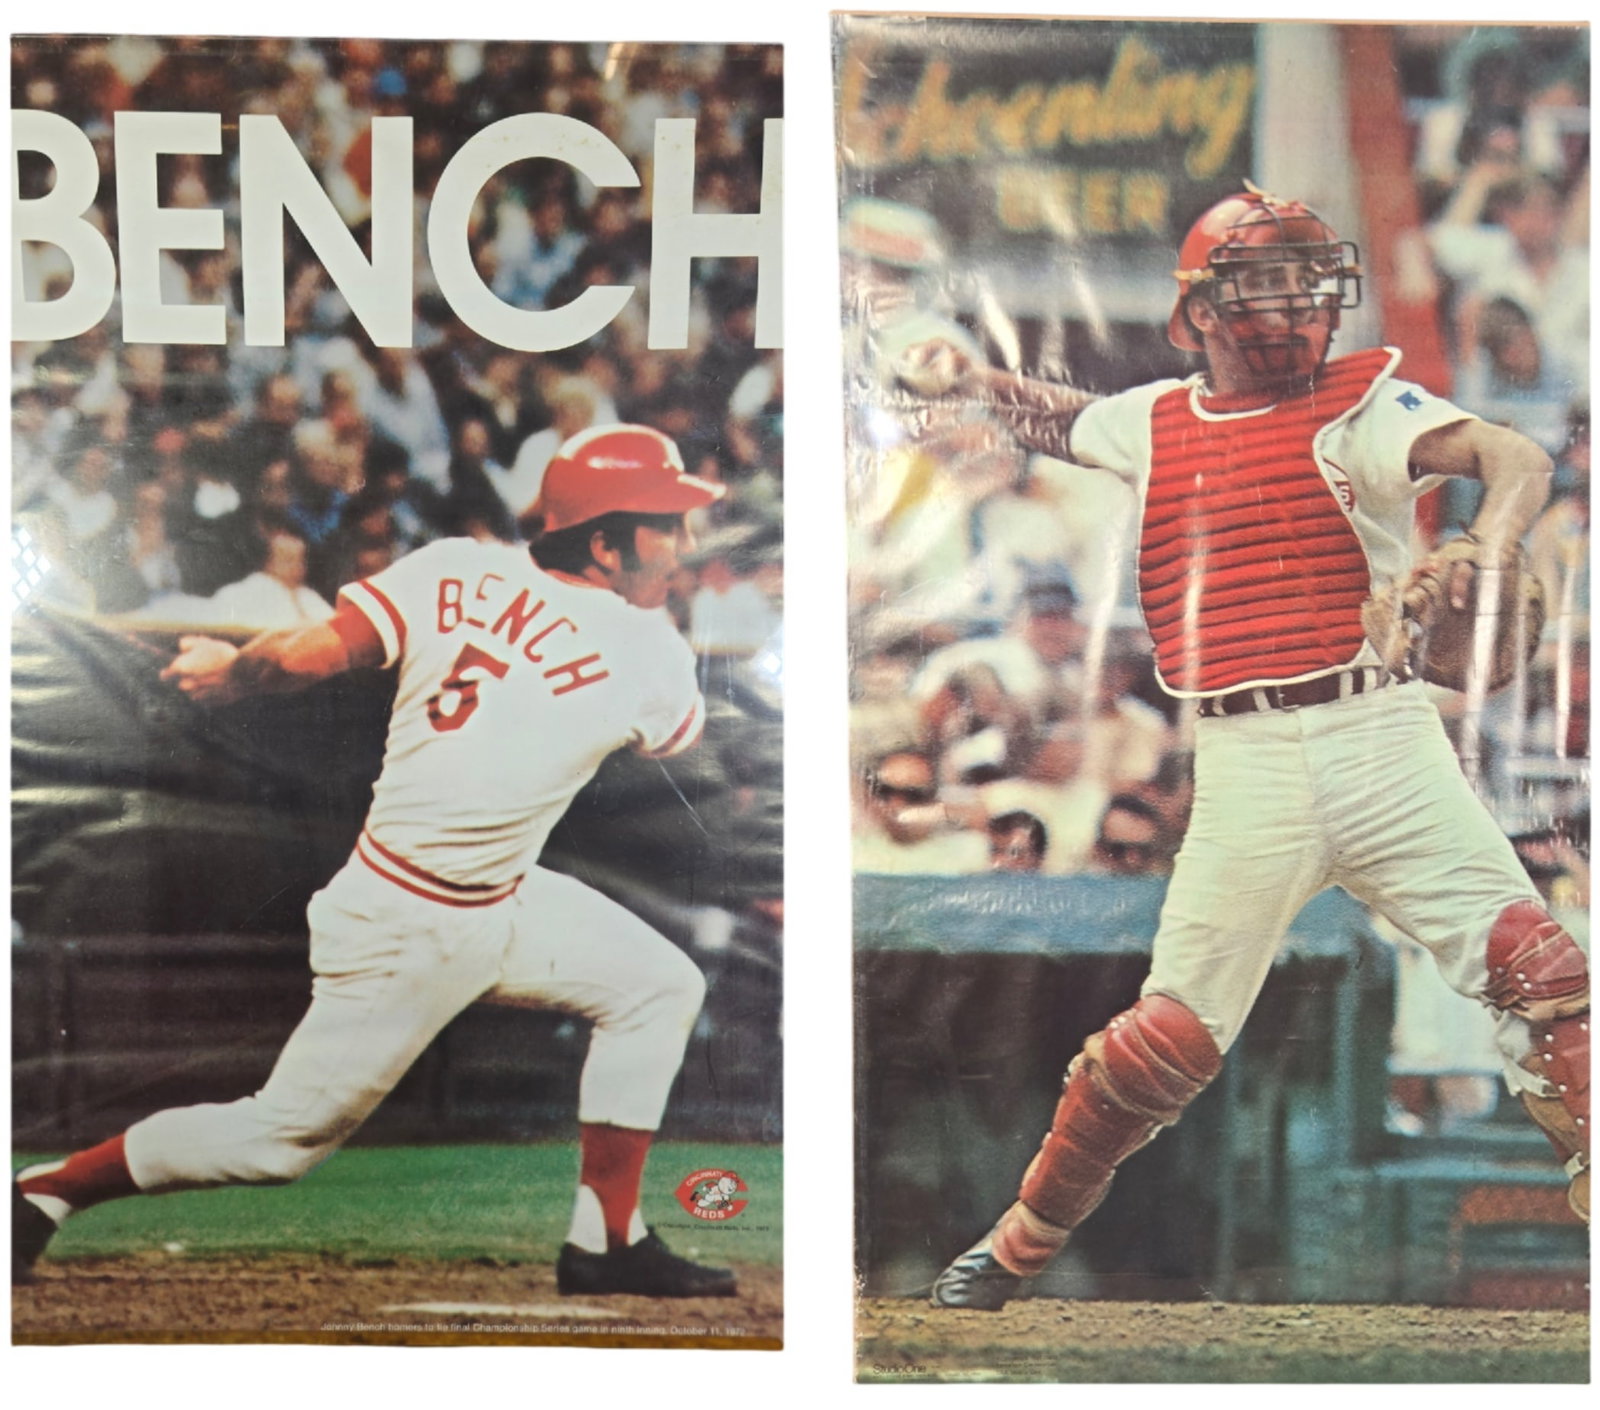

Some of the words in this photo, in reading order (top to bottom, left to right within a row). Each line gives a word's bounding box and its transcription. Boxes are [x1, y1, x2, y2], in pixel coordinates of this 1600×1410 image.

[11, 109, 784, 352] BENCH
[438, 573, 609, 696] BENCH
[427, 642, 510, 732] 5
[693, 1207, 725, 1219] REDS
[320, 1322, 354, 1333] Johnny
[356, 1322, 386, 1331] Bench
[388, 1323, 422, 1332] homers
[424, 1323, 433, 1332] to
[450, 1323, 469, 1332] final
[473, 1324, 539, 1335] Championship
[541, 1324, 570, 1333] Series
[572, 1324, 598, 1335] game
[600, 1325, 609, 1334] in
[611, 1325, 635, 1334] ninth
[670, 1325, 707, 1334] October
